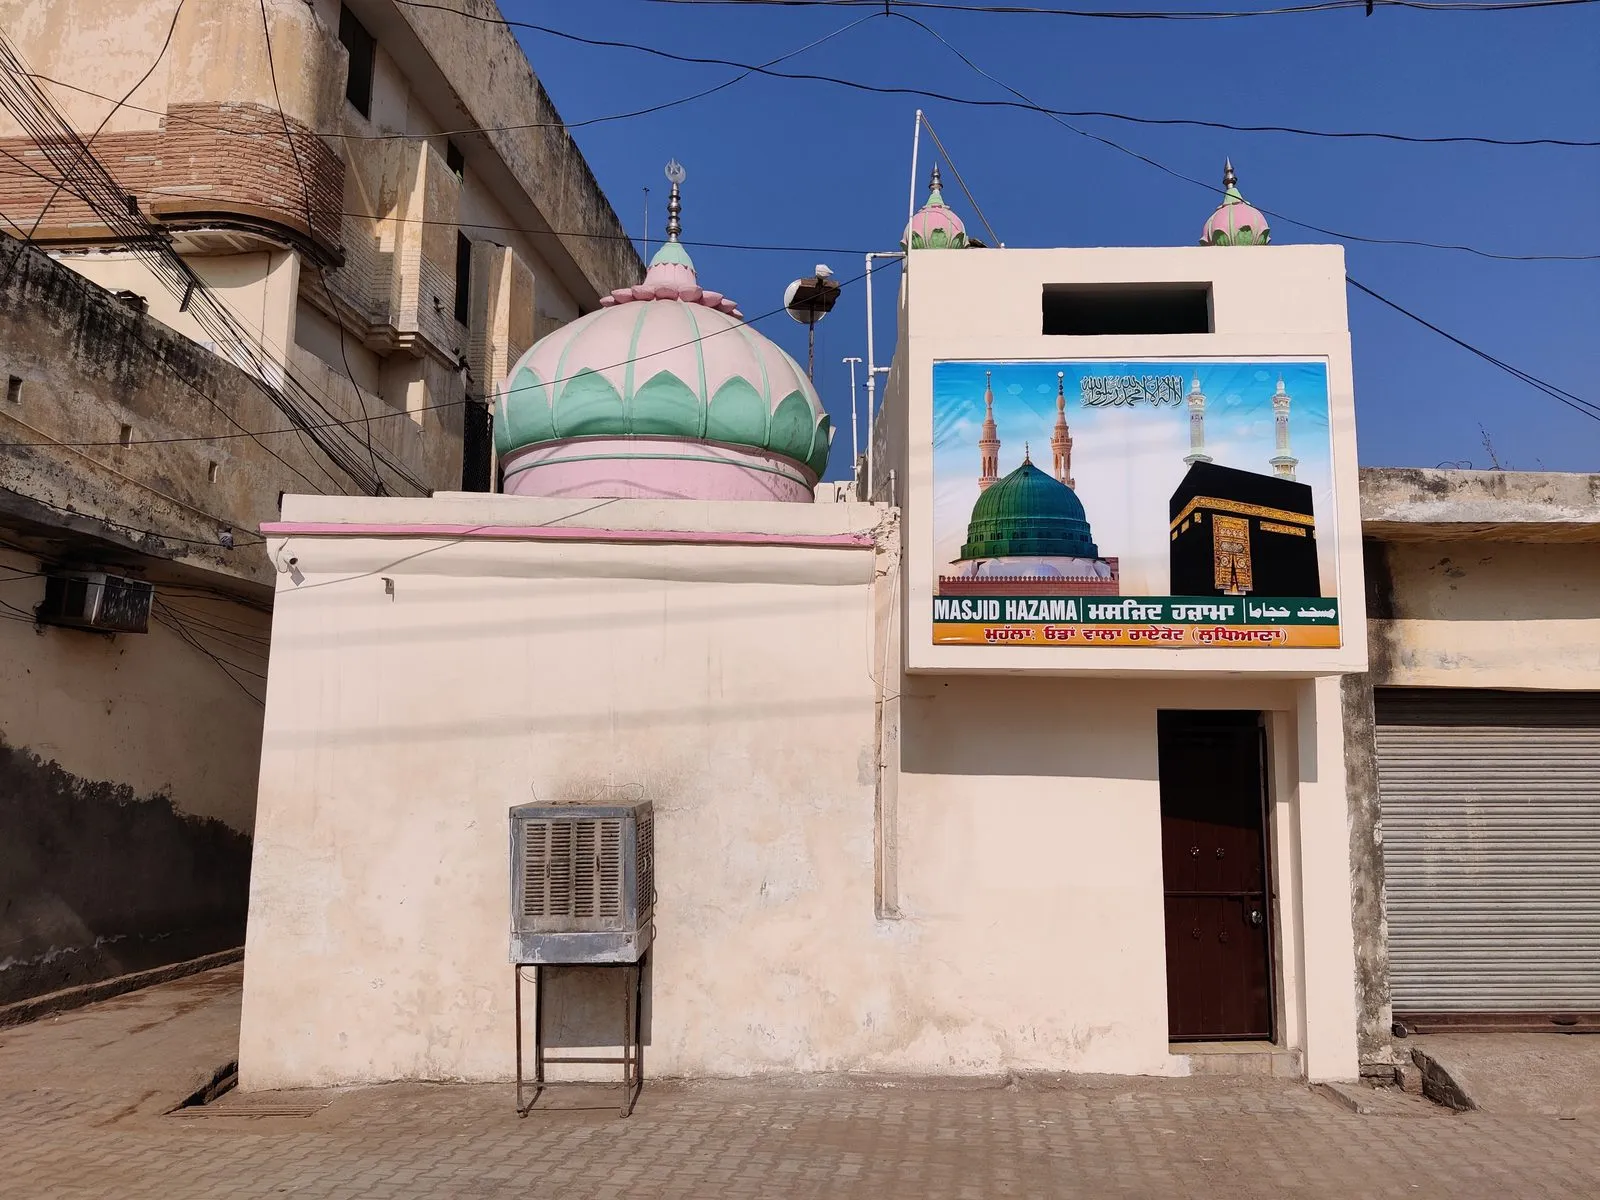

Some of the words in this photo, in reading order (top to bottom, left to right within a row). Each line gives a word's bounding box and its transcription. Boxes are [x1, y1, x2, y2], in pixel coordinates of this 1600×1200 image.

[934, 599, 1000, 620] MASJID
[1005, 599, 1078, 621] HAZAMA
[1088, 600, 1163, 620] ਮਸਜਿਦ
[1249, 602, 1291, 622] حجاما
[1297, 607, 1336, 622] مسجد
[1082, 629, 1122, 640] ਵਾਲਾ
[1128, 625, 1184, 641] ਰਾਏਕੋਟ
